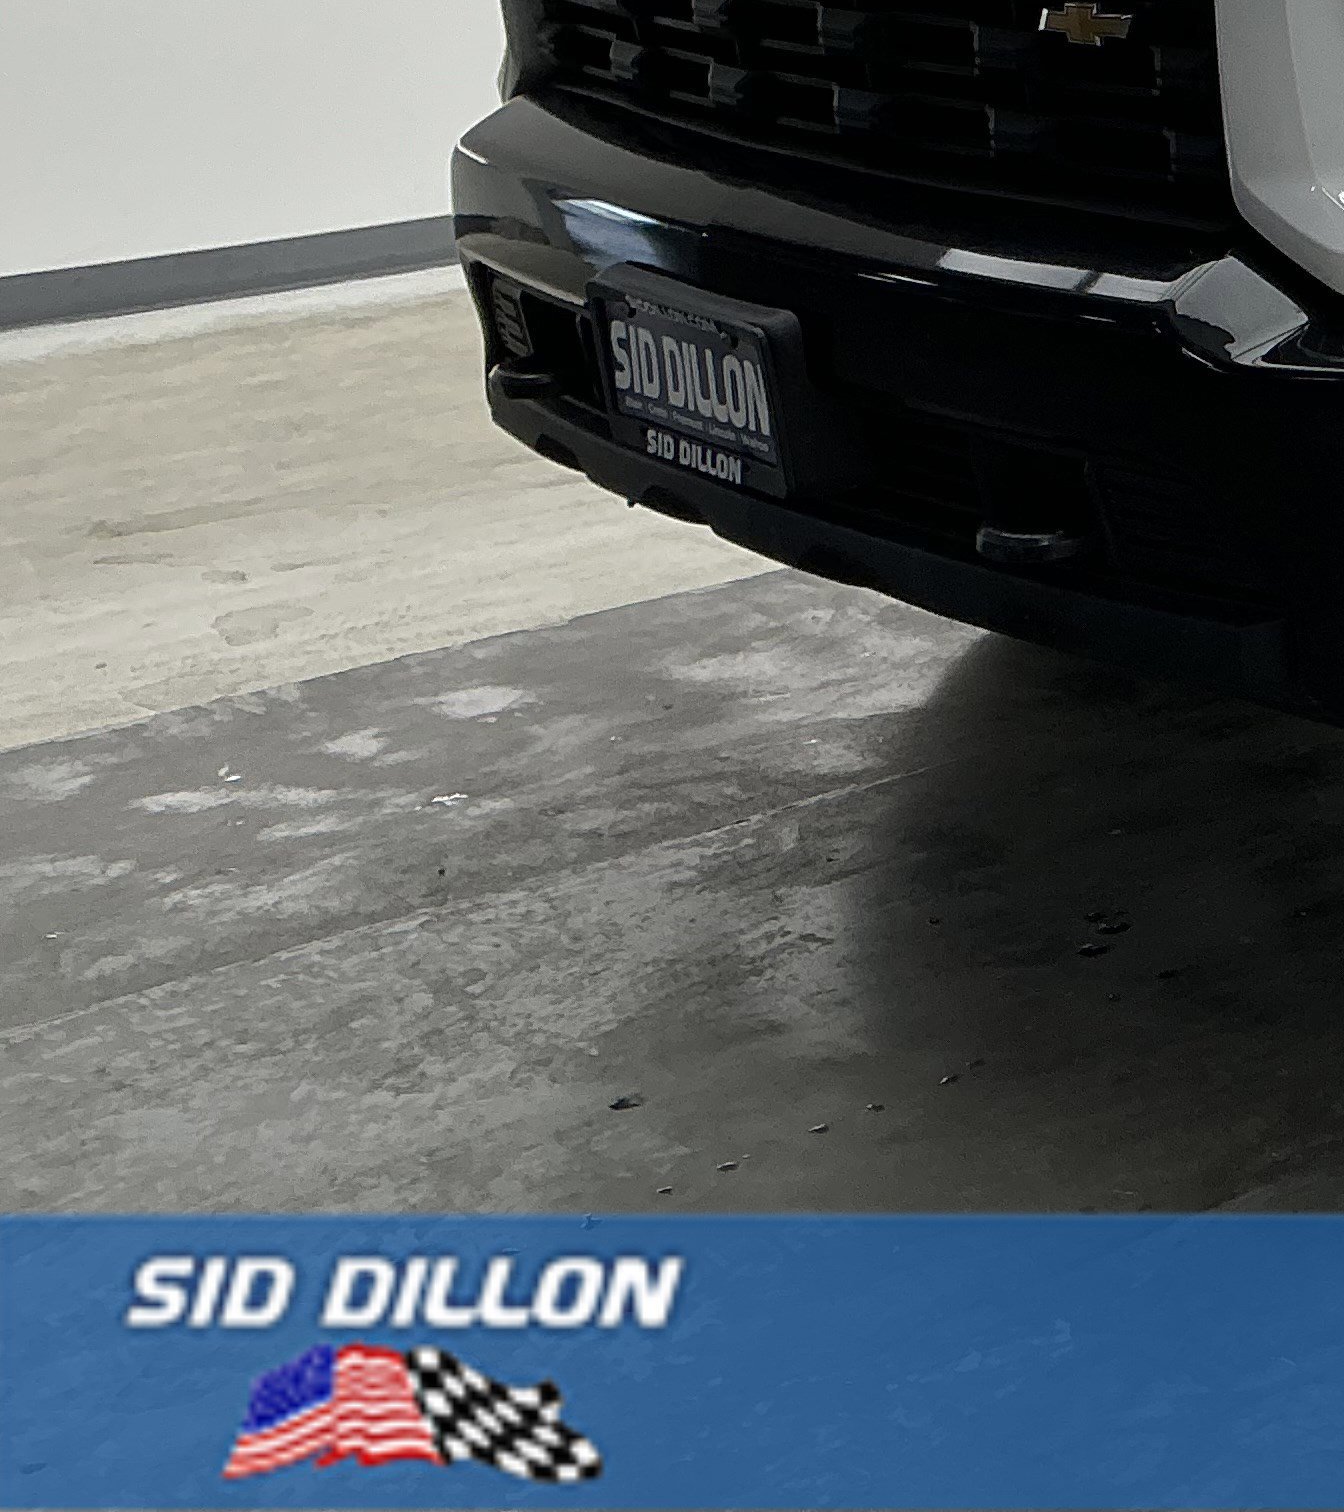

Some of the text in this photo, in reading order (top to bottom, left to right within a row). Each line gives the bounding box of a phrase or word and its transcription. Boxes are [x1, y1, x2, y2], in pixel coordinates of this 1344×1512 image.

[610, 319, 661, 399] SID
[661, 334, 771, 437] DILLON
[646, 428, 742, 485] SID DILLON
